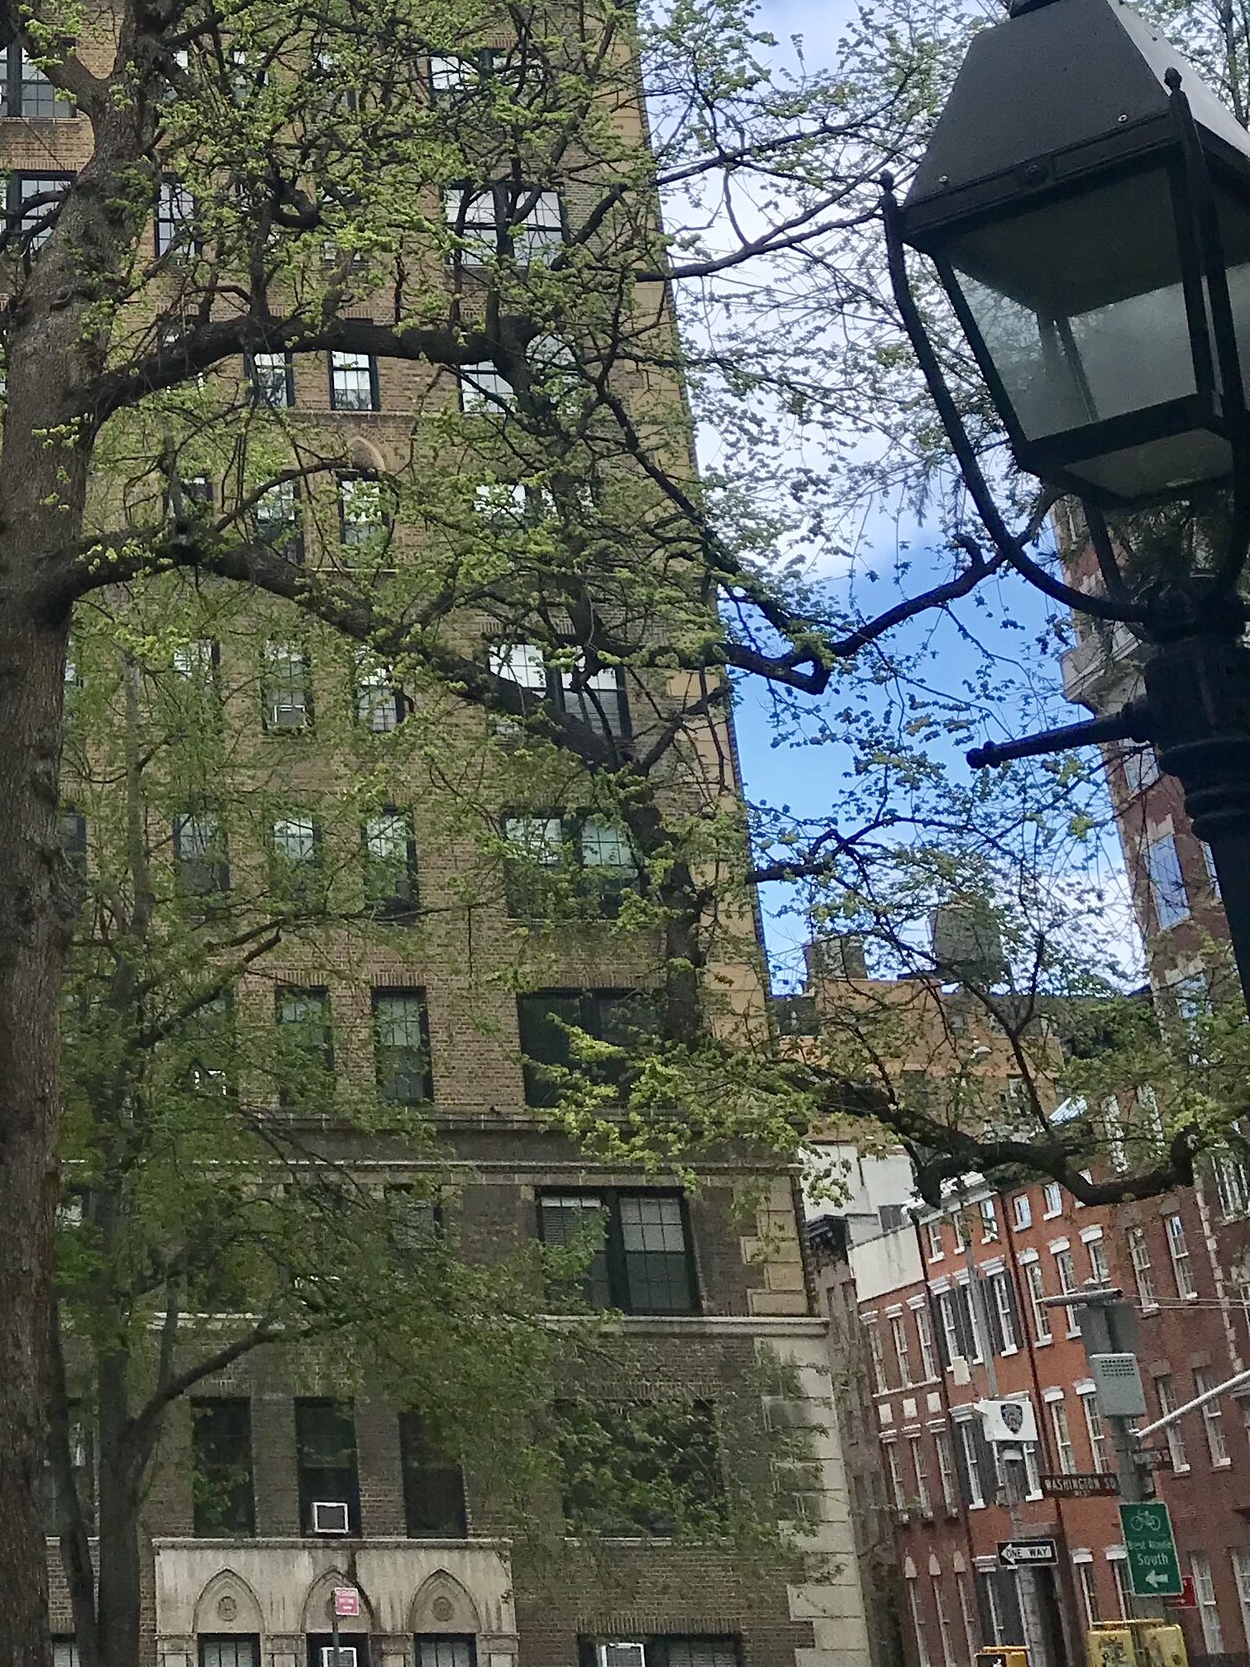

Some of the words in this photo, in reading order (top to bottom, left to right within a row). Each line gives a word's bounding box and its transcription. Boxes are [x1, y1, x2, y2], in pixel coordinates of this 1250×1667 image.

[1044, 1477, 1100, 1491] WASHINGTON
[1104, 1476, 1117, 1490] SQ
[1006, 1547, 1022, 1559] ONE
[1029, 1547, 1048, 1557] WAY
[1137, 1552, 1169, 1566] South
